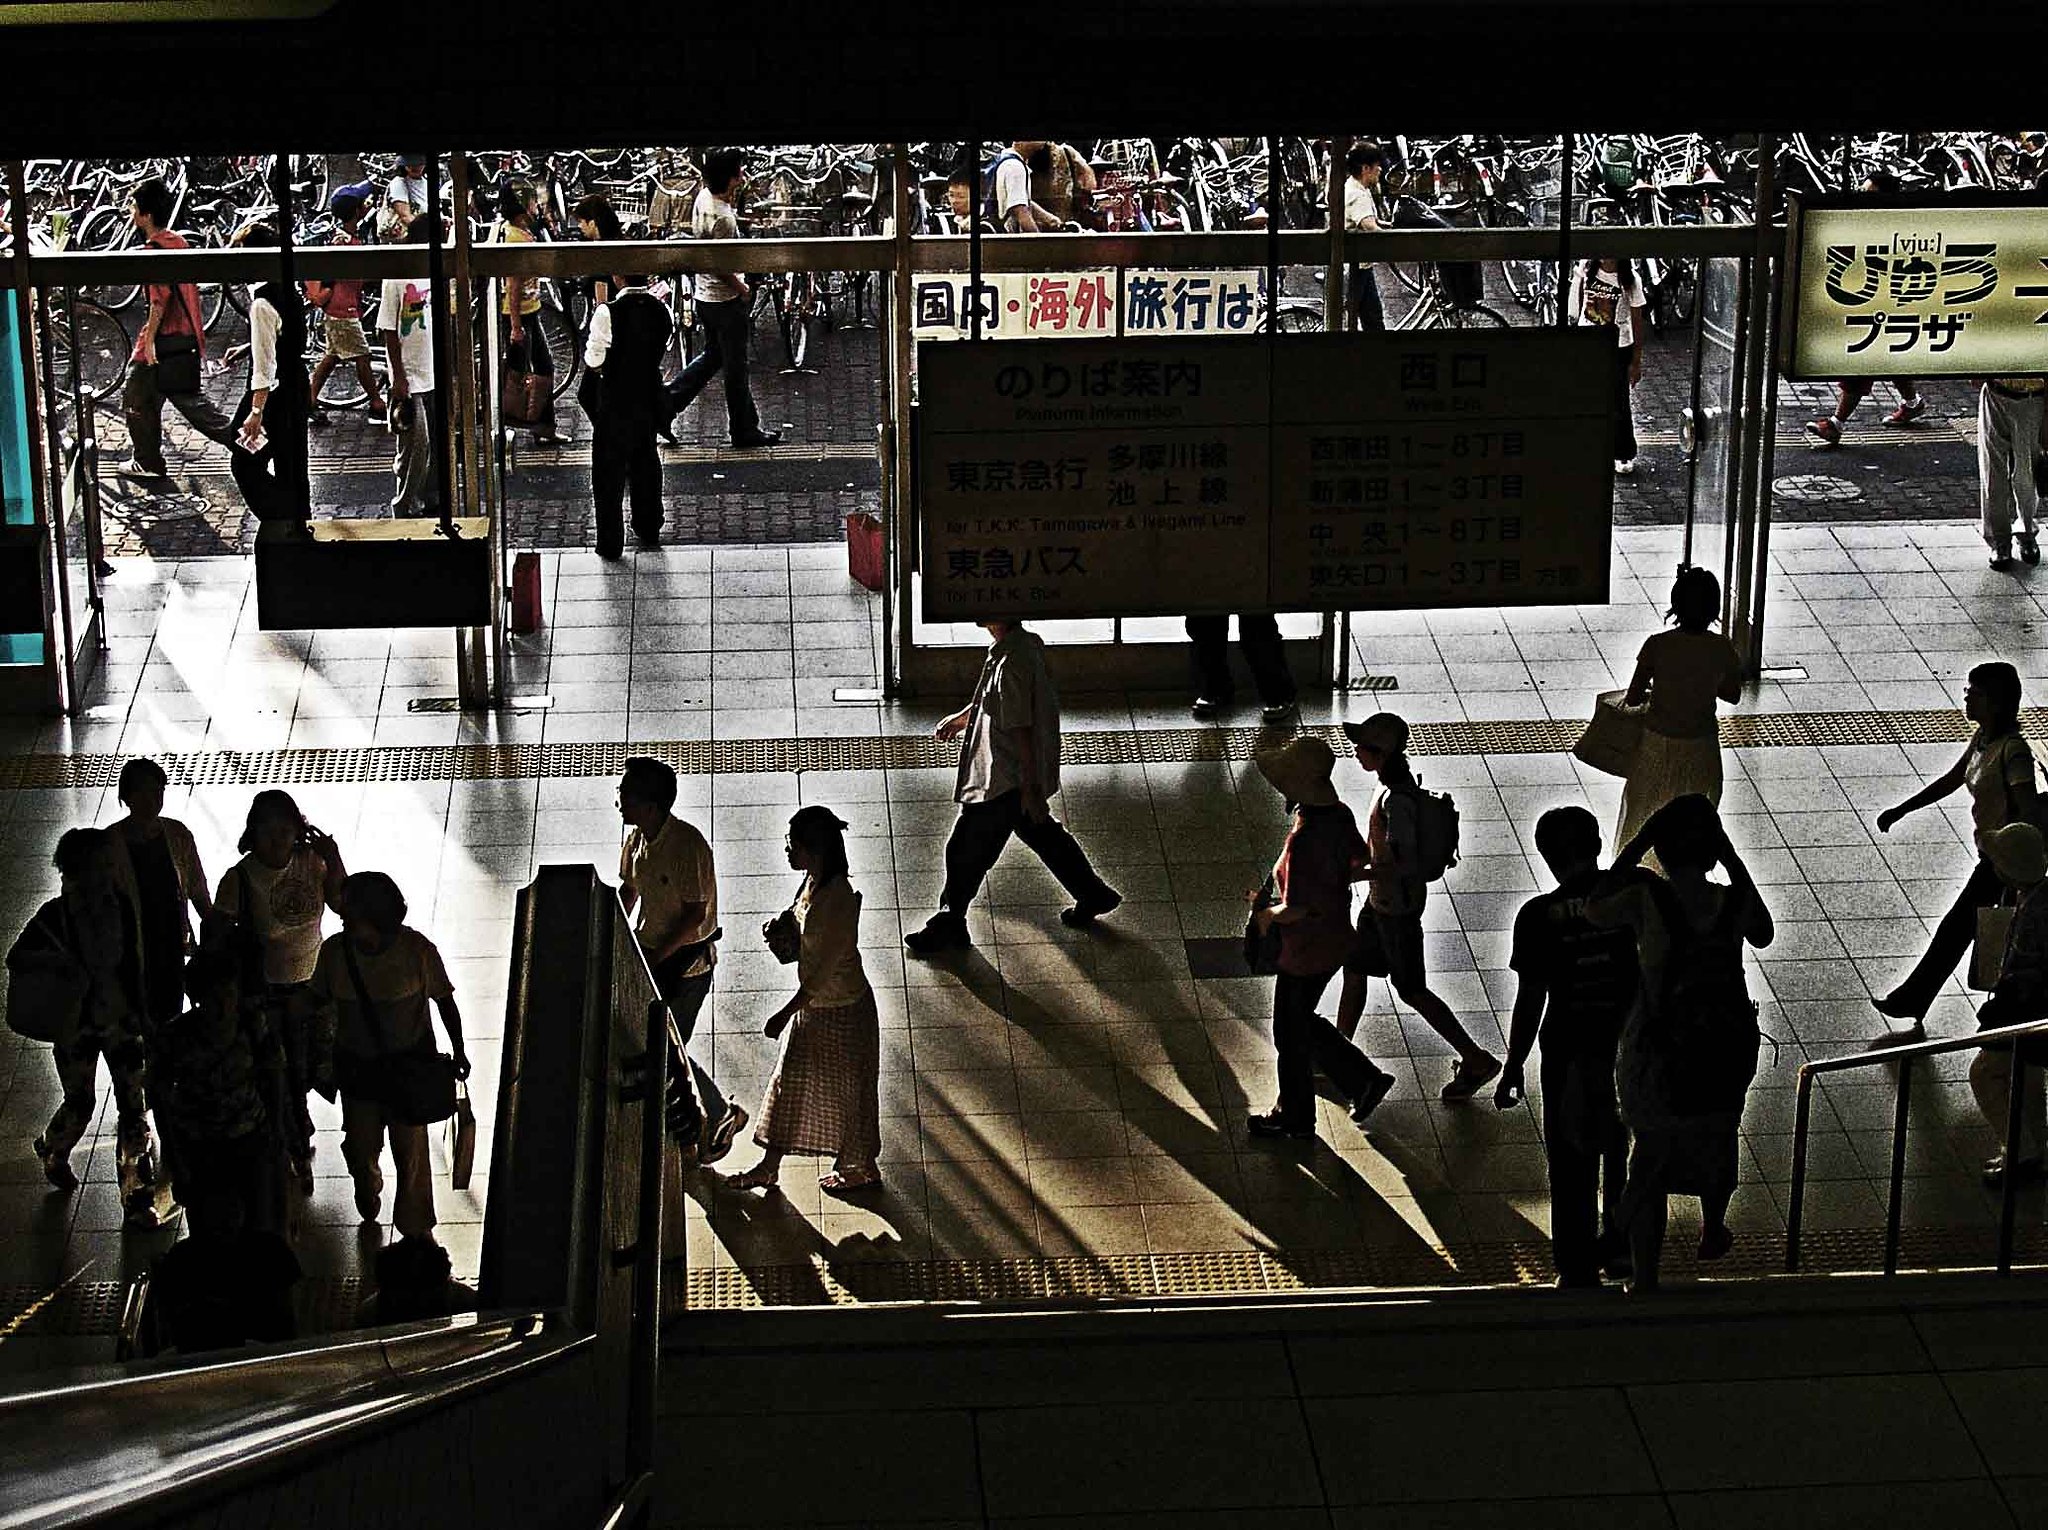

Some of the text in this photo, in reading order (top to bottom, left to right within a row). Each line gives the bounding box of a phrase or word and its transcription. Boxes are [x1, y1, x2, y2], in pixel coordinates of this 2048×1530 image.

[1893, 233, 1942, 254] [vju:]
[1825, 244, 1998, 307] びゅう
[1846, 311, 1972, 352] プラザ
[995, 358, 1201, 398] のりば案内
[1400, 352, 1488, 391] 西口
[946, 458, 1088, 491] 東京急行
[1212, 513, 1247, 528] Line
[946, 546, 1088, 579] 東急バス
